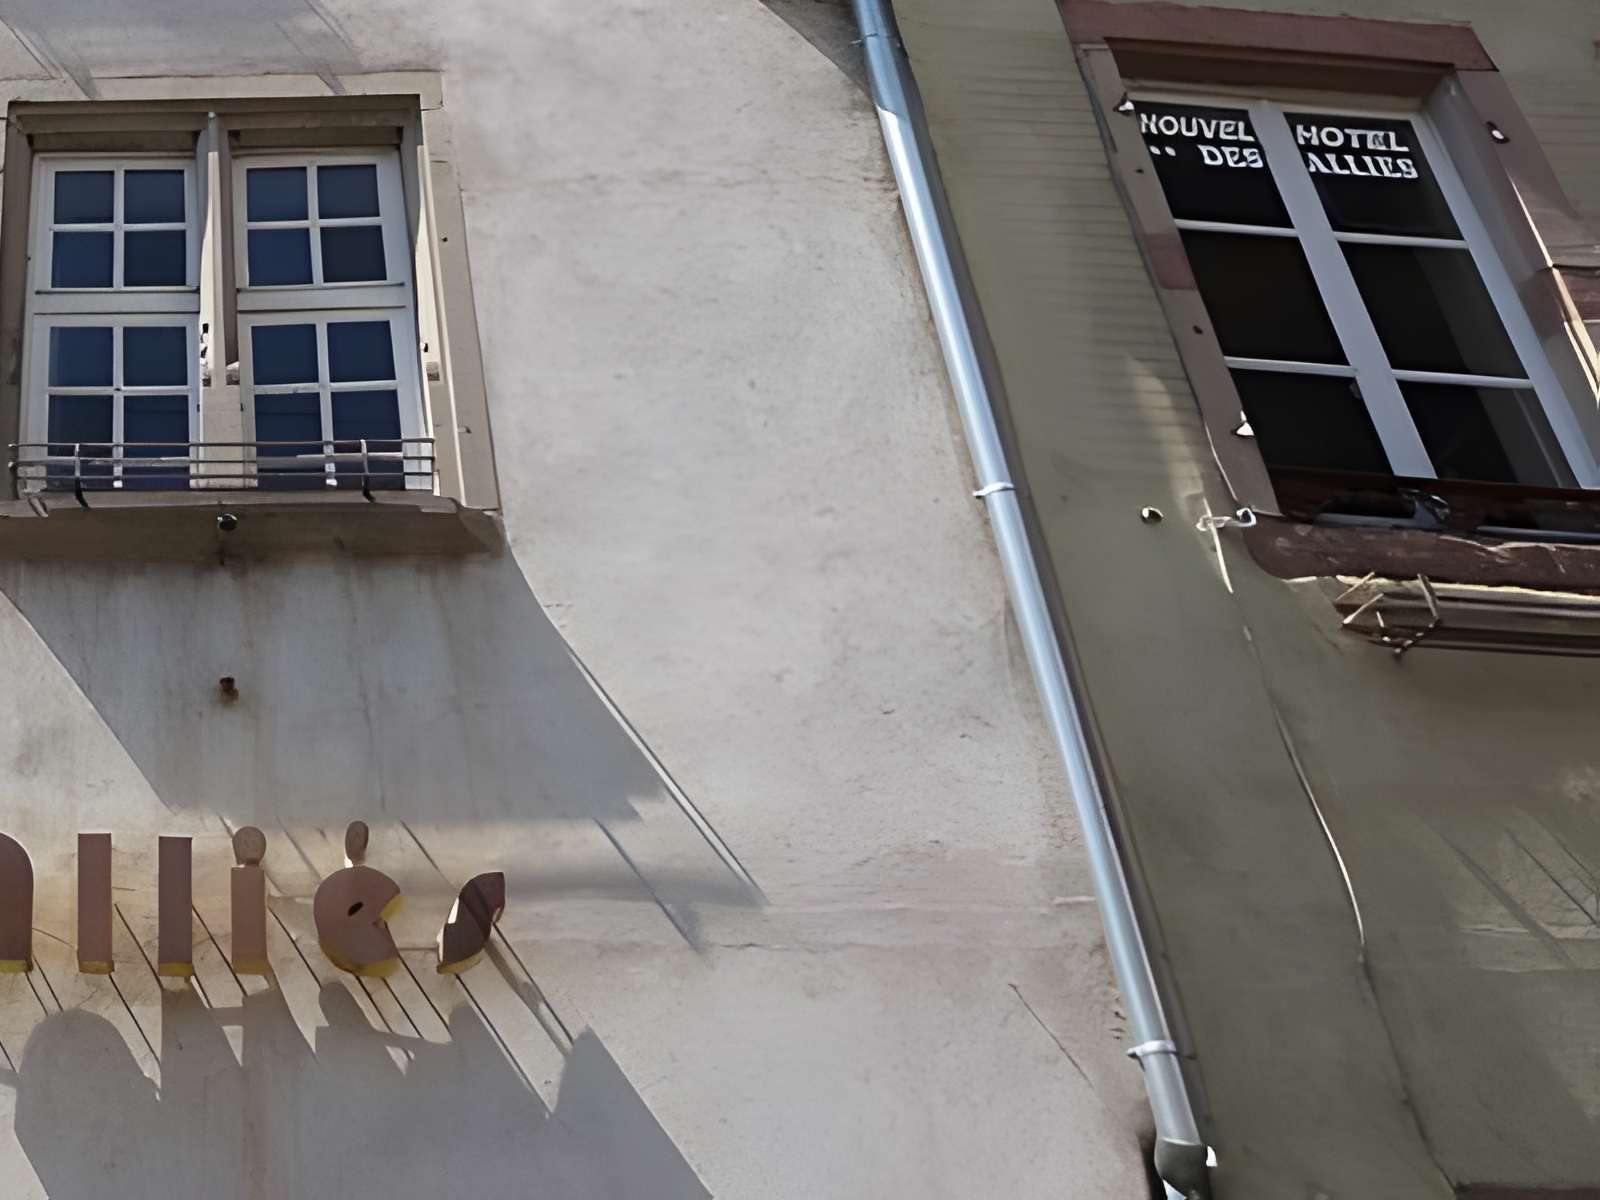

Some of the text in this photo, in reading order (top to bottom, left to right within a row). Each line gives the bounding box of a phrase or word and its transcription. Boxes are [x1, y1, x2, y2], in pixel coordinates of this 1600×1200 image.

[1140, 113, 1408, 151] NOUVEL HOTEL
[1199, 145, 1418, 178] DES ALLIES
